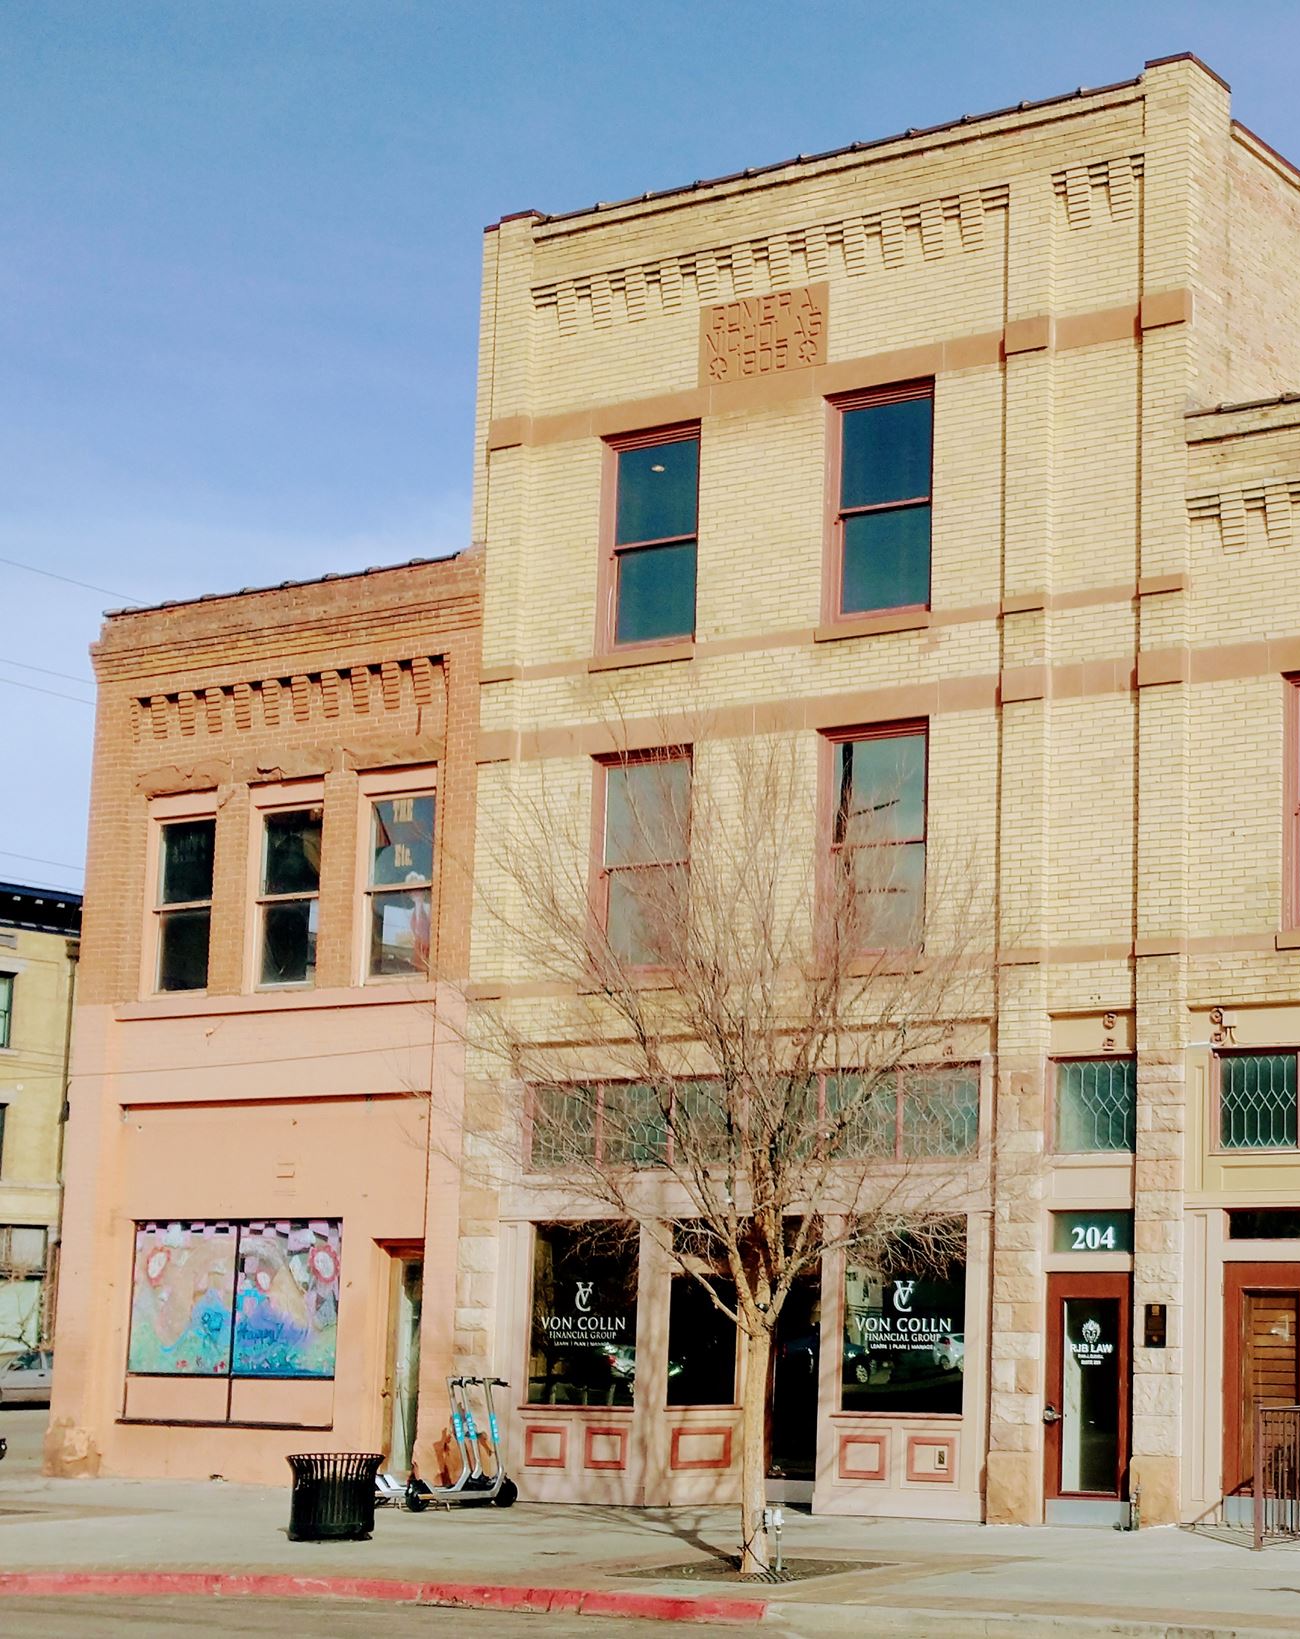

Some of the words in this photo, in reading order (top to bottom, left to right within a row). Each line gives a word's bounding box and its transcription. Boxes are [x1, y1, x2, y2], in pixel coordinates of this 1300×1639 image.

[706, 312, 821, 354] NICHOLAS
[1071, 1226, 1115, 1249] 204
[541, 1316, 572, 1330] VON
[577, 1316, 626, 1330] COLLN
[855, 1317, 891, 1332] VON
[896, 1317, 952, 1332] COLLN
[549, 1331, 588, 1339] FINANCIAL
[590, 1331, 617, 1339] GROUP
[864, 1332, 909, 1341] FINANCIAL
[911, 1333, 942, 1342] GROUP
[1090, 1344, 1113, 1354] LAW
